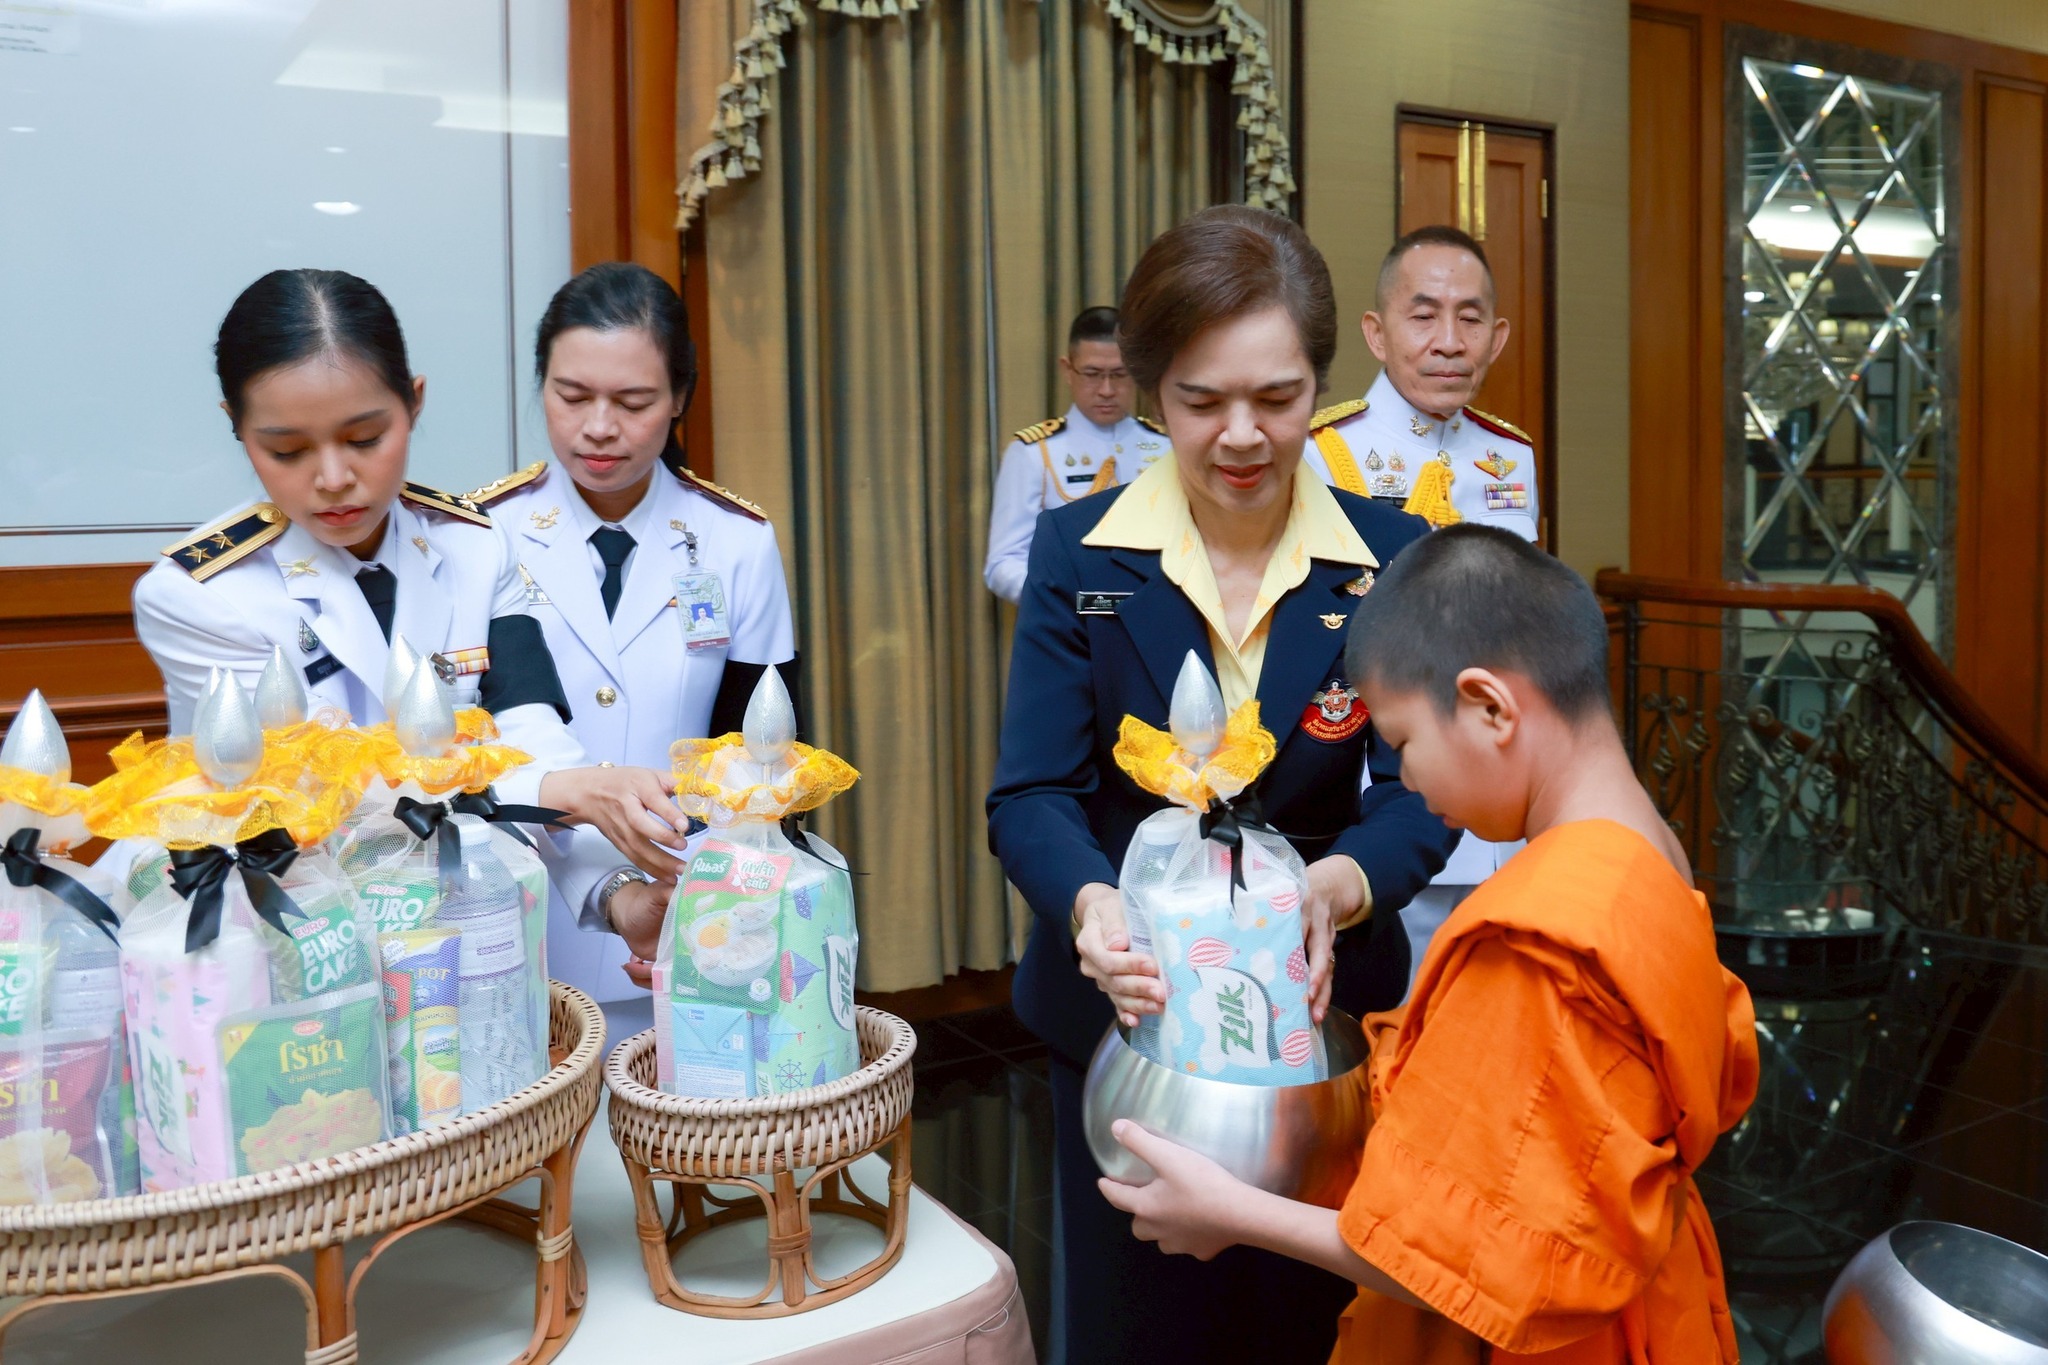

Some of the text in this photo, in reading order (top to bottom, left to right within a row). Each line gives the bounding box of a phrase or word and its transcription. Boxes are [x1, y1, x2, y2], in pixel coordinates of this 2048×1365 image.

[355, 898, 424, 922] EURO
[293, 917, 330, 940] EURO
[300, 919, 356, 970] EURO
[305, 951, 358, 993] CAKE
[412, 967, 450, 981] POT
